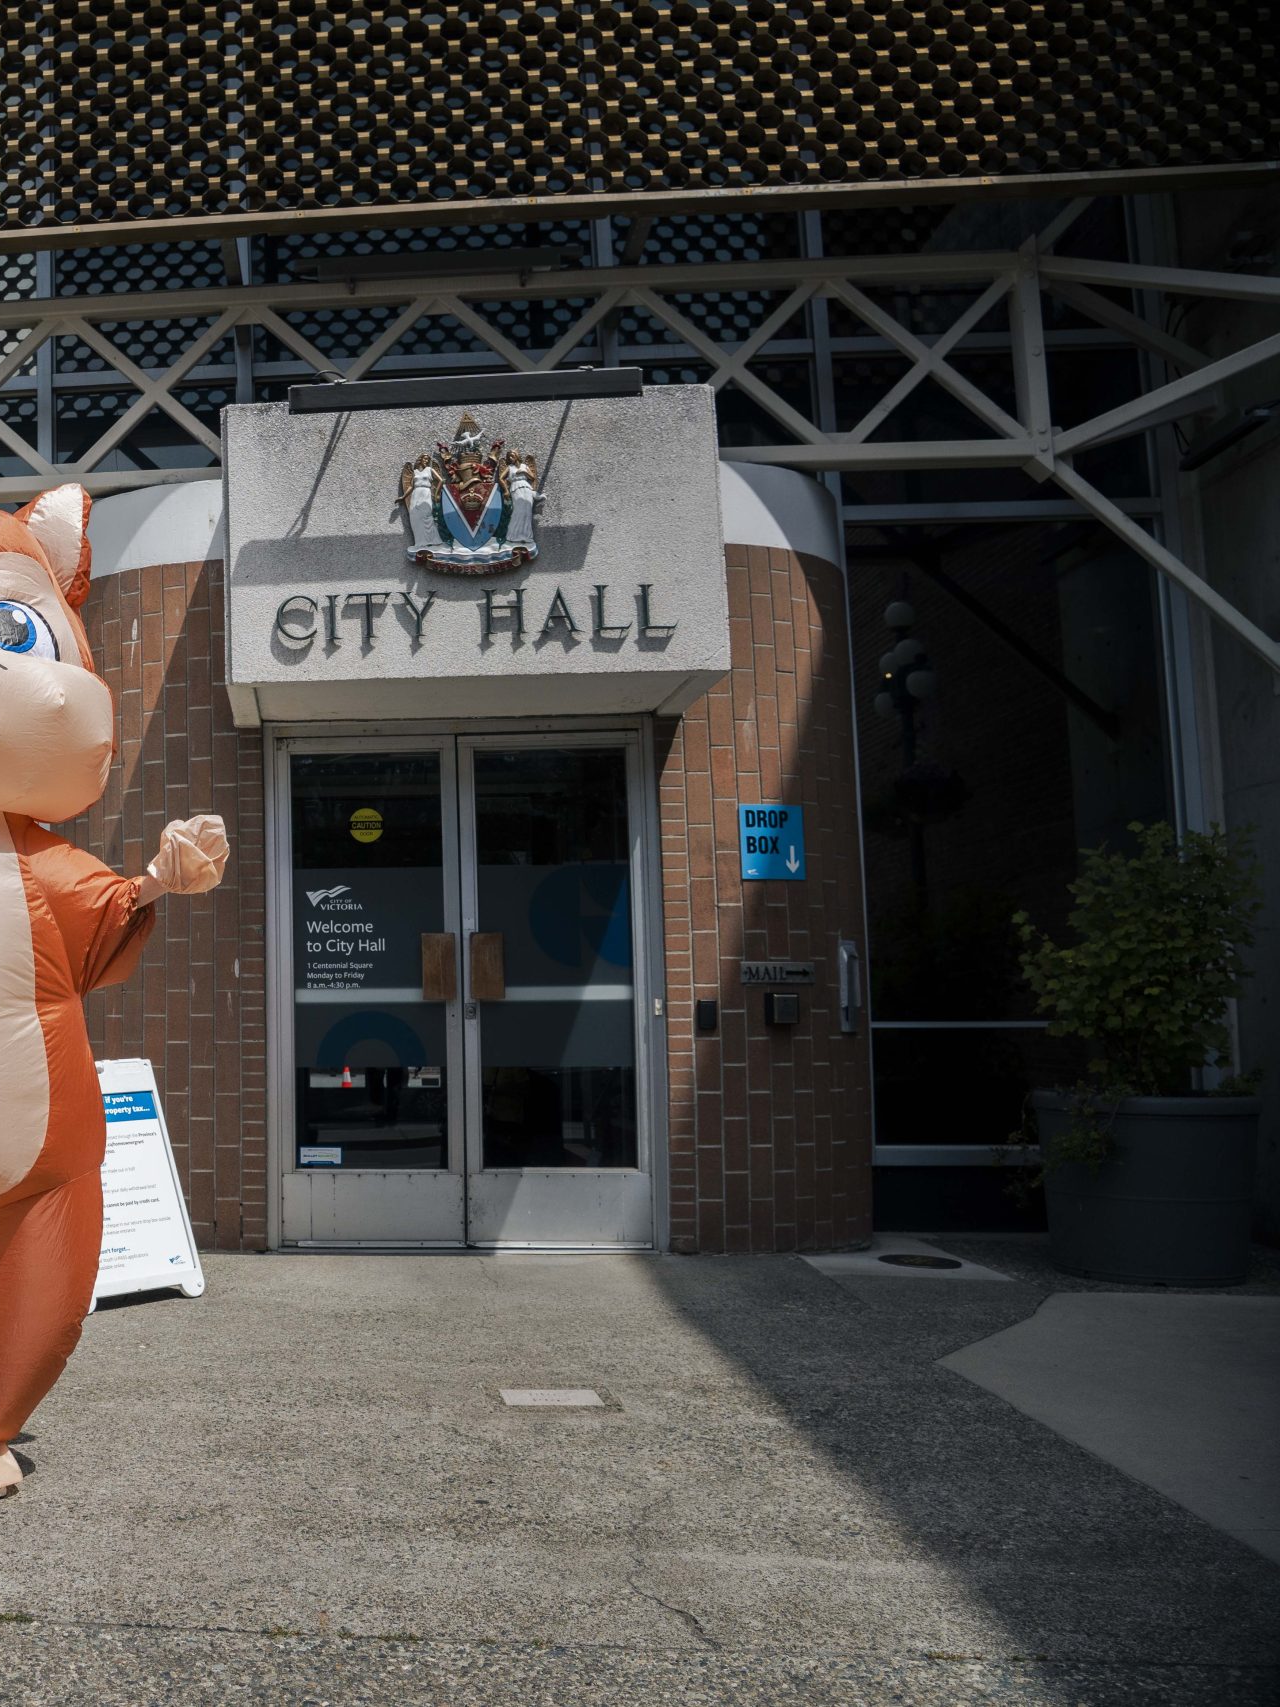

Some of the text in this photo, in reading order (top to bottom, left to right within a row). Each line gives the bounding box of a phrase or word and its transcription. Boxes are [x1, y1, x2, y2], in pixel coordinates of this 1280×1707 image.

[276, 584, 679, 640] CITY HALL
[745, 809, 788, 829] DROP
[351, 821, 382, 830] CAUTION
[746, 836, 780, 854] BOX
[320, 903, 363, 911] VICTORIA
[306, 920, 374, 934] Welcome
[306, 938, 386, 956] to City Hall
[312, 961, 349, 969] Centennial
[349, 961, 374, 970] Square
[306, 972, 334, 980] Monday
[343, 971, 365, 980] Friday
[745, 965, 787, 981] MAIL
[345, 982, 361, 990] p.m.
[111, 1095, 134, 1105] you're
